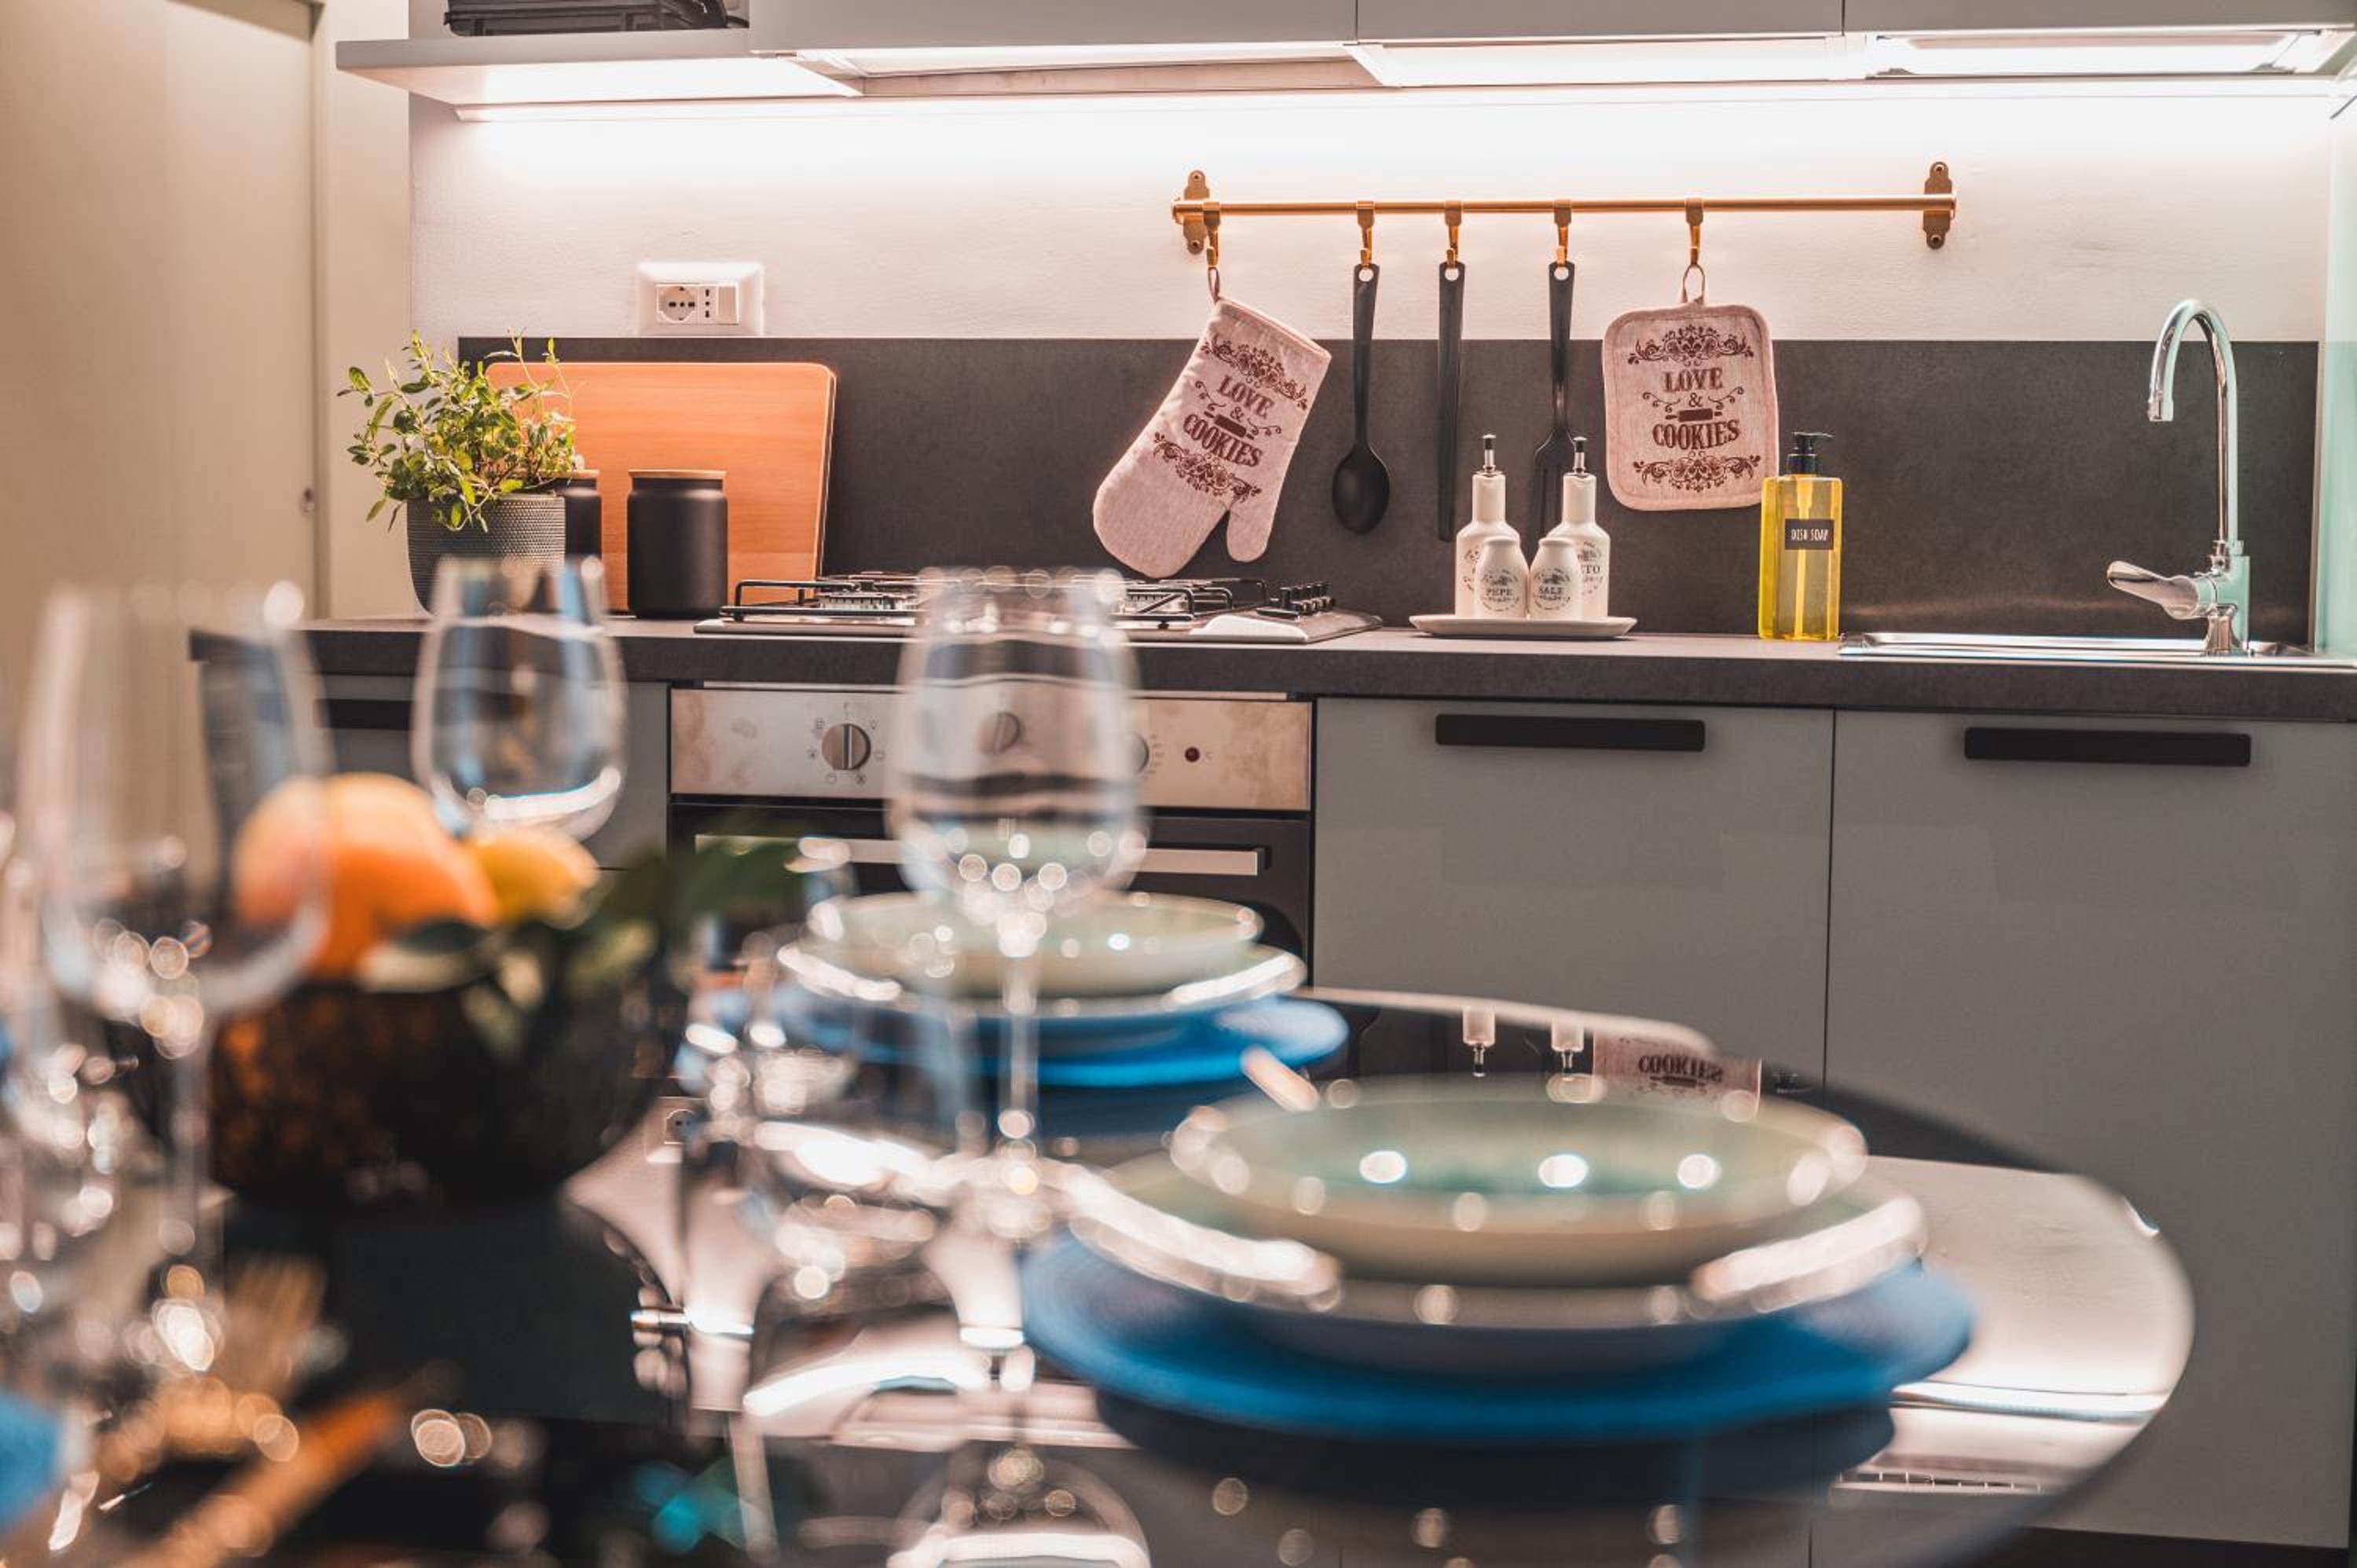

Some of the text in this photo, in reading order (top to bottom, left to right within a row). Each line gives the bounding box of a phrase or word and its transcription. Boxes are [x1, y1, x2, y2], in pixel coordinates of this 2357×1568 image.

[1663, 367, 1723, 393] LOVE
[1217, 375, 1275, 419] LOVE
[1688, 393, 1703, 408] &
[1230, 406, 1244, 422] &
[1182, 413, 1263, 467] COOKIES
[1652, 419, 1740, 450] COOKIES
[1791, 529, 1828, 541] DISH SOAP
